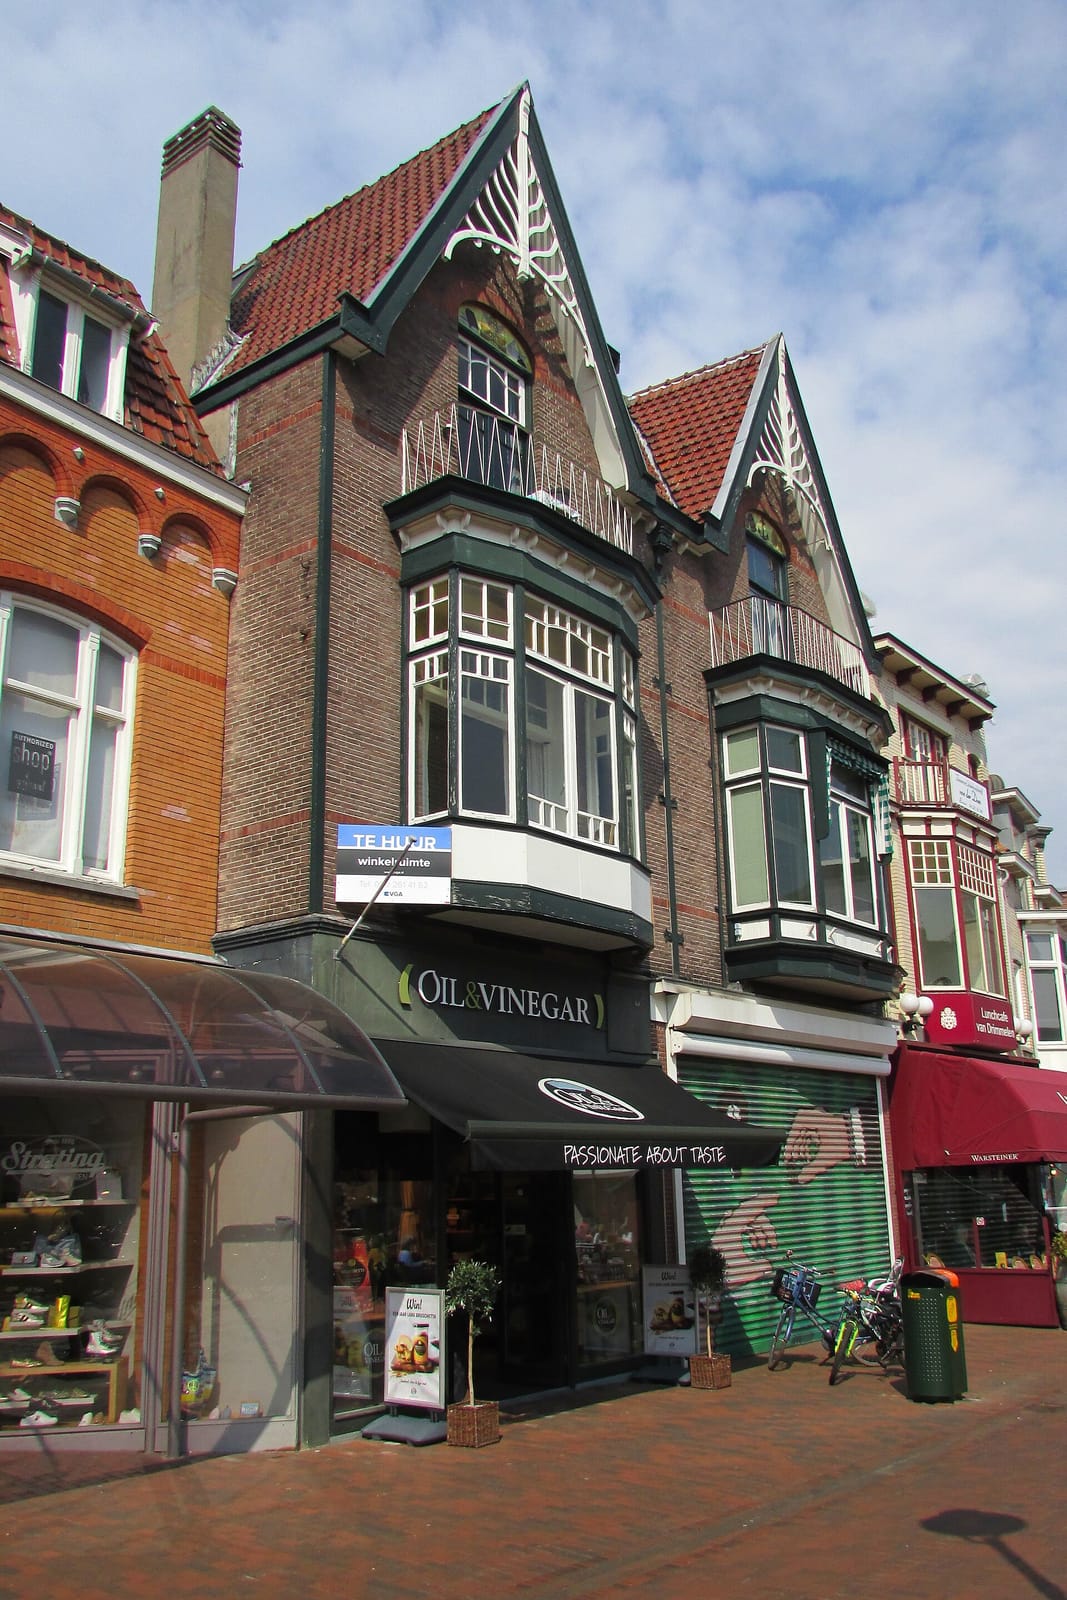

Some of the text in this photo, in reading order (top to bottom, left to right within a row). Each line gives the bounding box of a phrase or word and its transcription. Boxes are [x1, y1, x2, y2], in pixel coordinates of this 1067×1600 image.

[14, 733, 54, 749] AUTHORIZED
[353, 834, 436, 849] TE HUUR
[418, 969, 465, 1007] OIL
[477, 982, 591, 1025] VINEGAR
[976, 1022, 987, 1033] van
[563, 1145, 727, 1165] PASSIONATE ABOUT TASTE
[971, 1153, 1019, 1162] WARSTEINER
[406, 1298, 423, 1310] Win!
